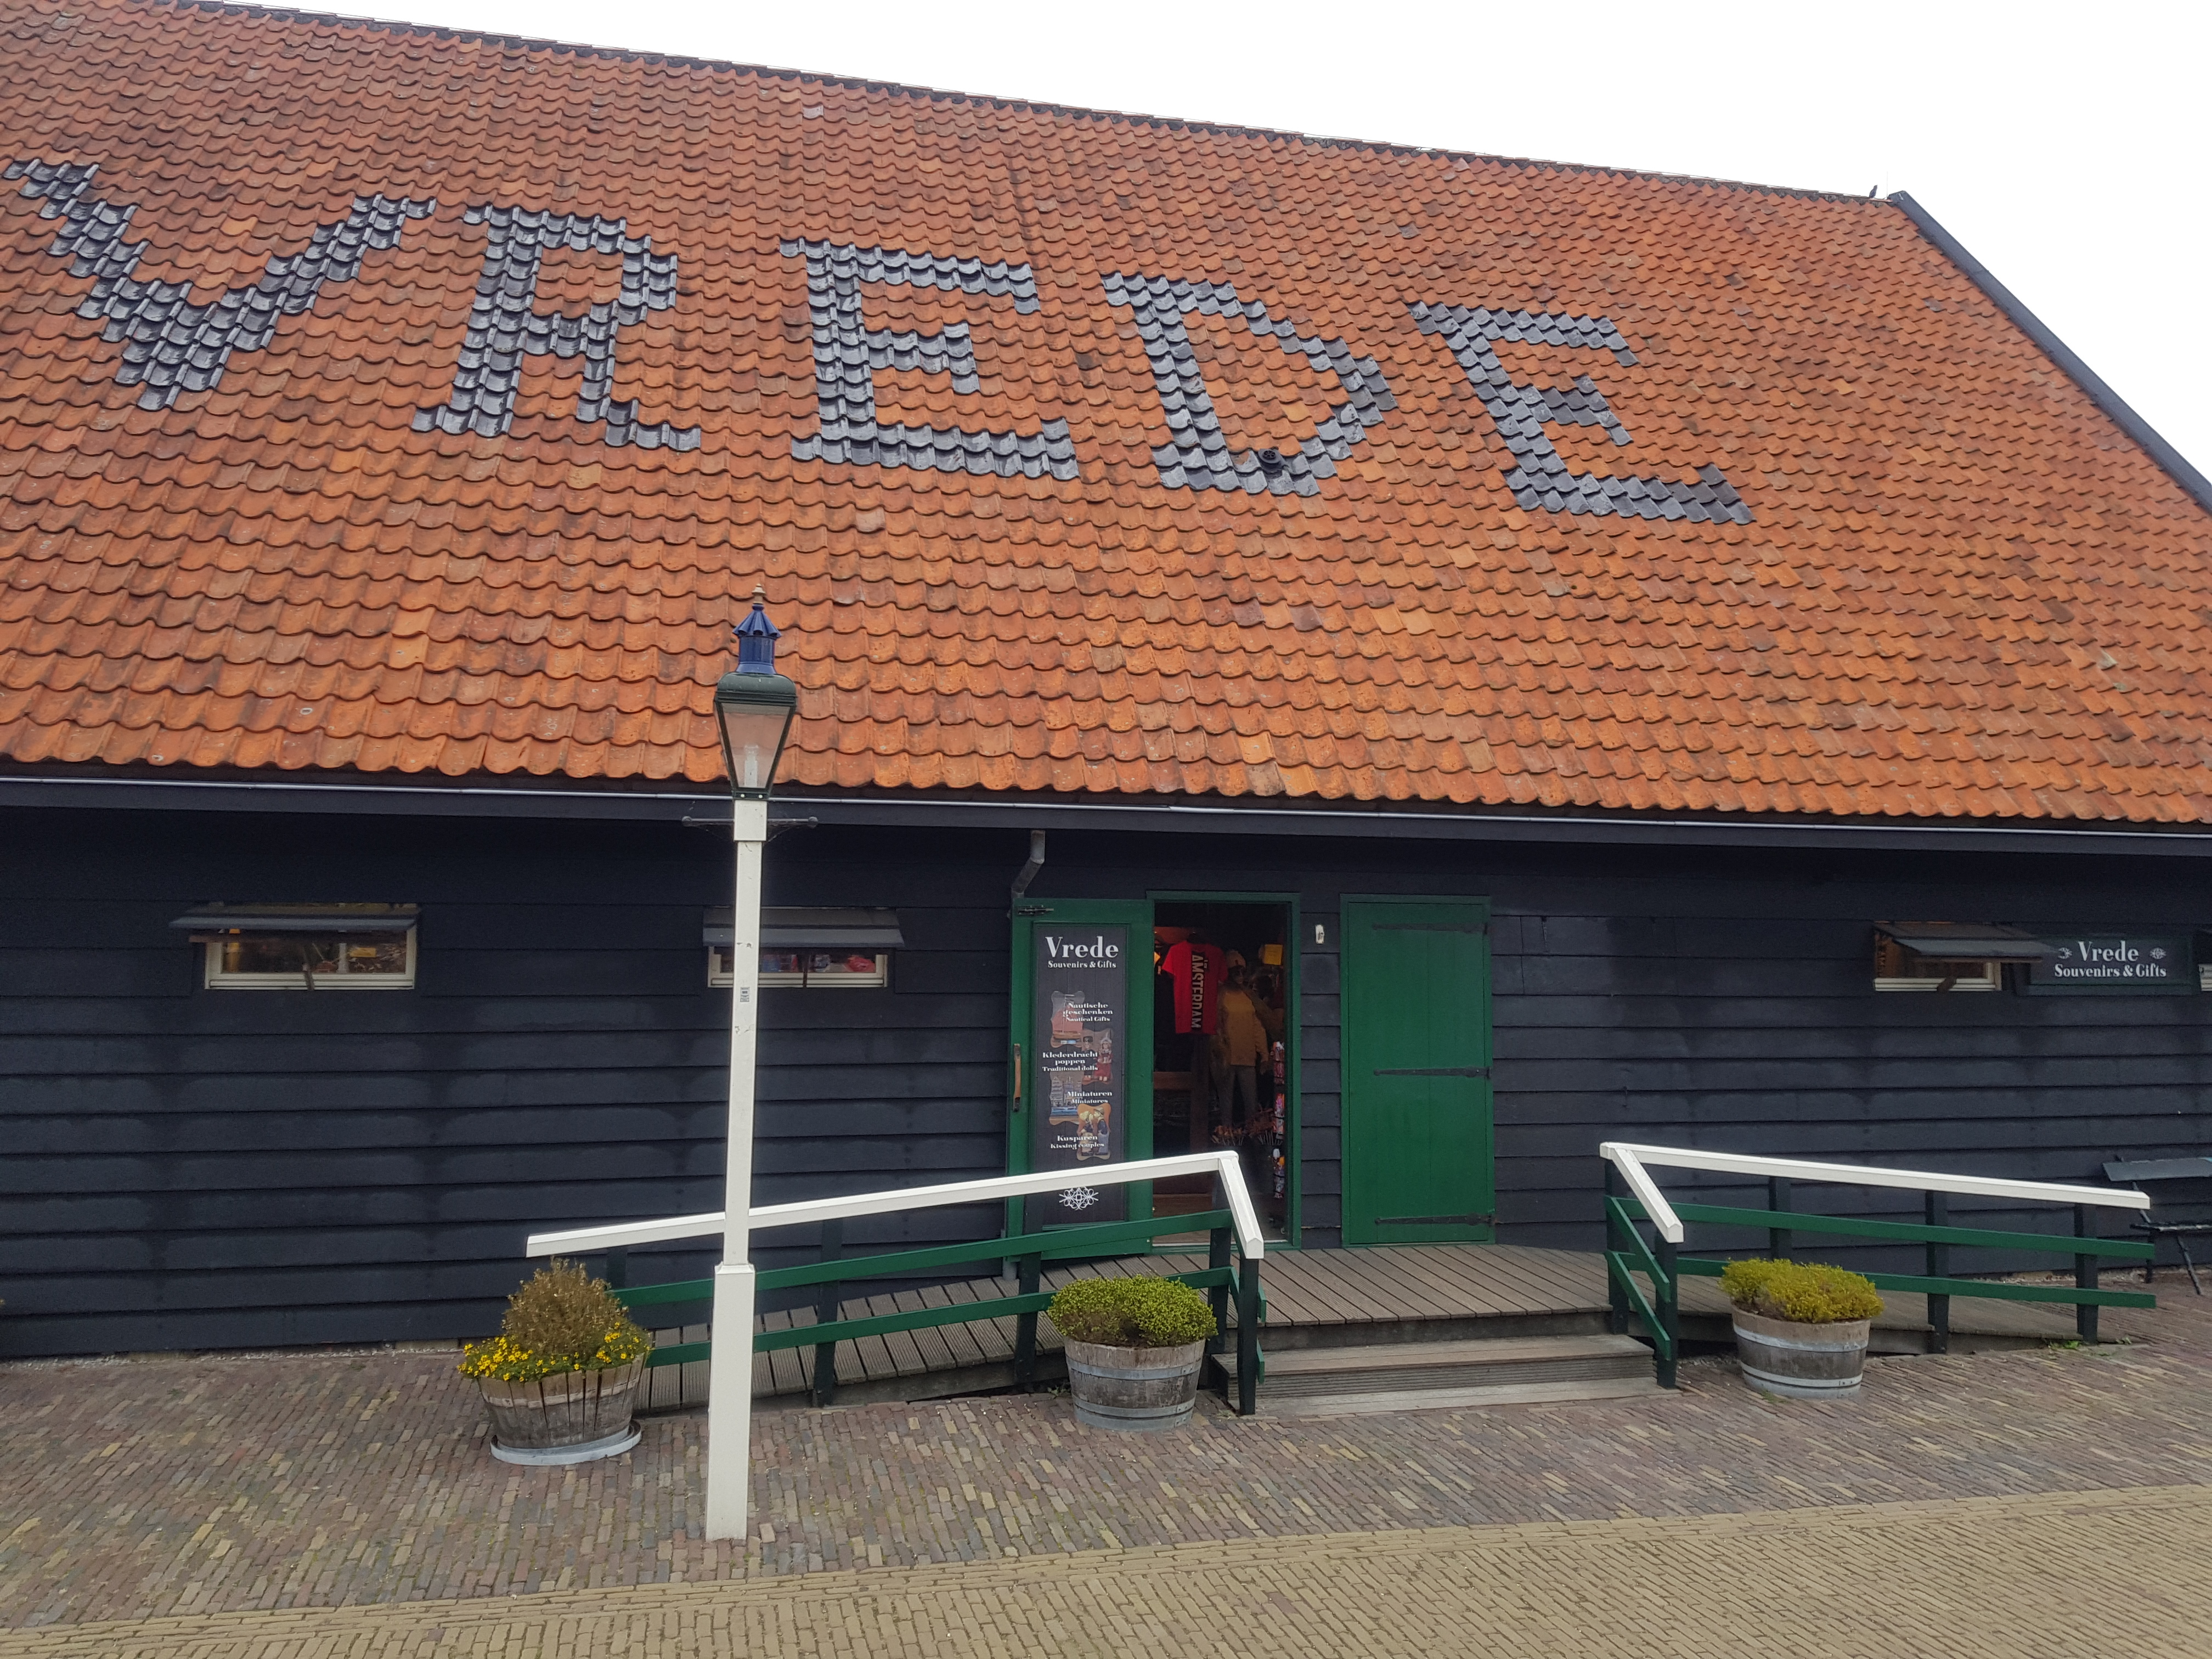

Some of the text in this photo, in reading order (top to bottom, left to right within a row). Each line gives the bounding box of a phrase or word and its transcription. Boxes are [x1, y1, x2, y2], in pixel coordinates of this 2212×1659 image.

[3, 157, 1754, 525] VREDE
[1045, 935, 1119, 958] Vrede
[2078, 940, 2139, 961] Vrede
[2055, 963, 2166, 977] Souvenirs & Gifts
[1191, 955, 1204, 1028] AMSTERDAM
[1063, 1009, 1113, 1017] geschenken
